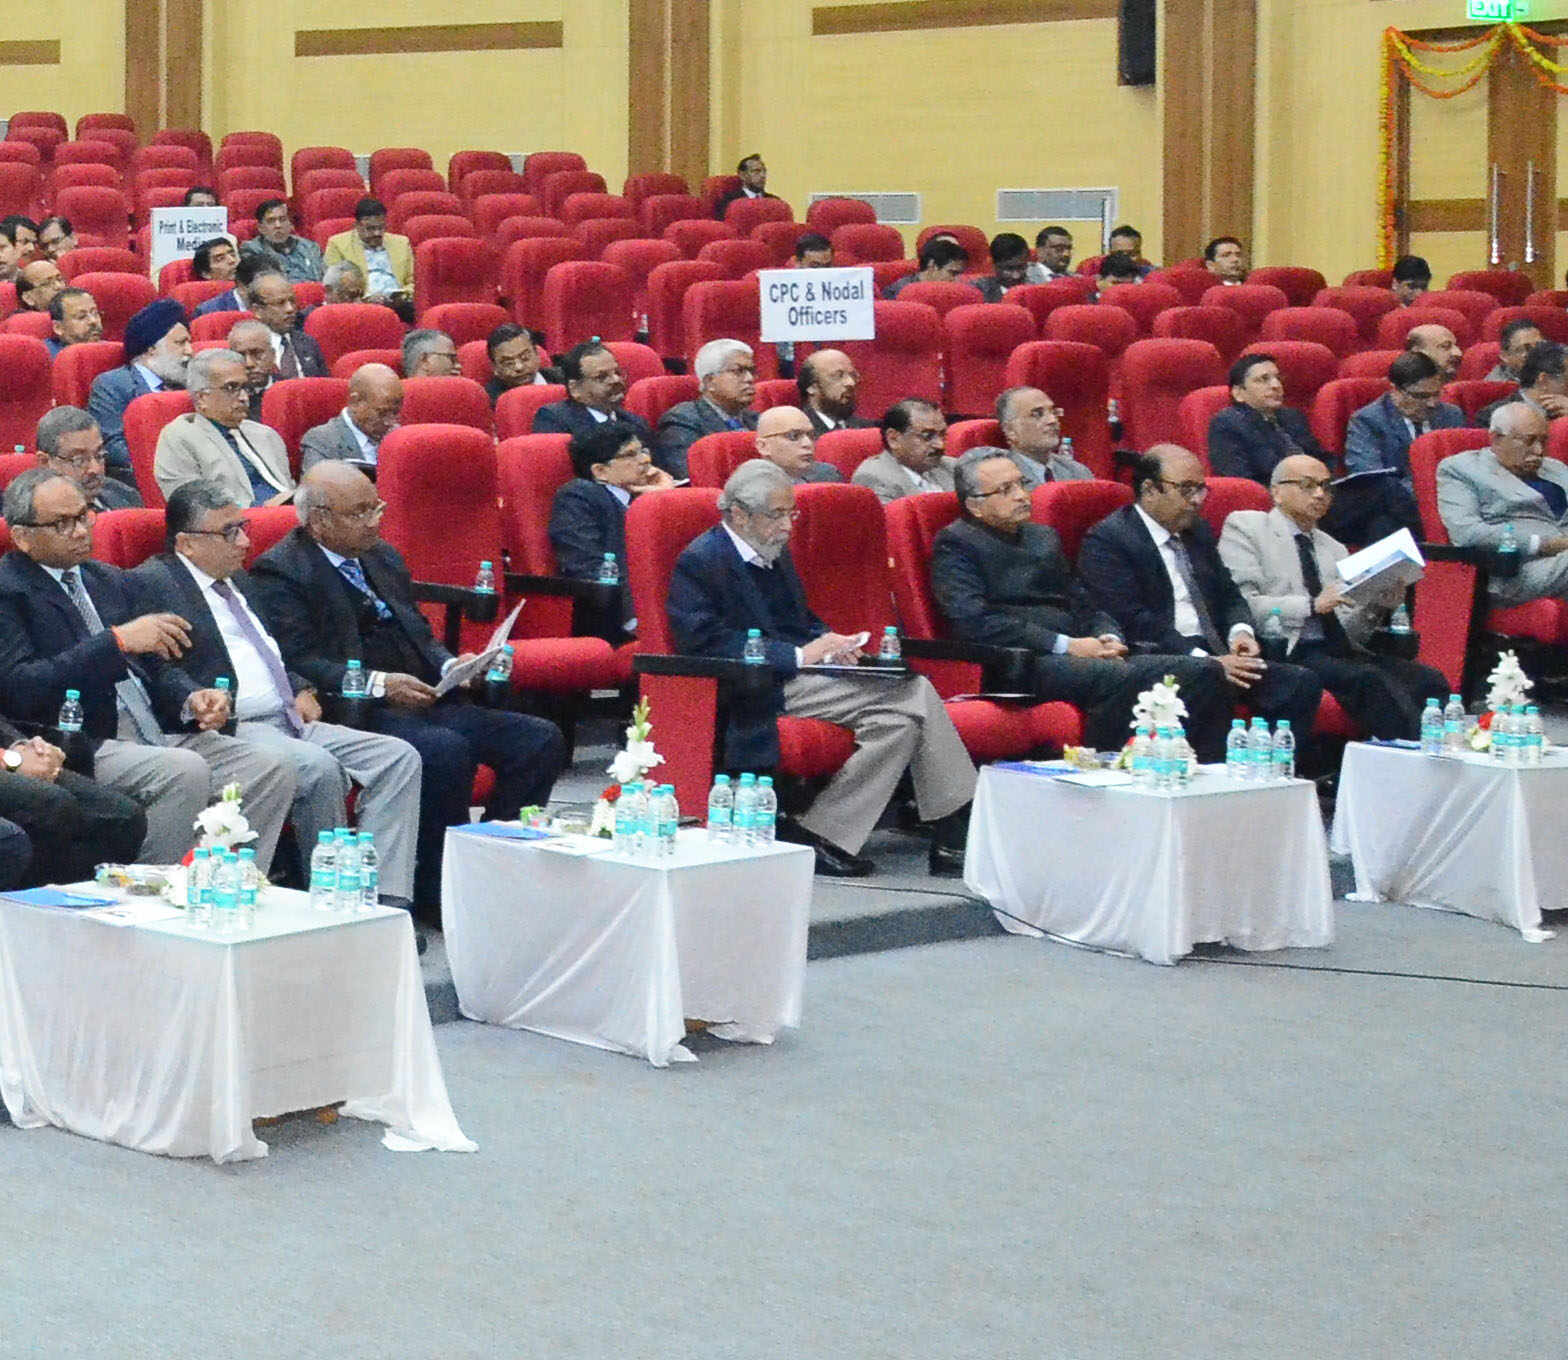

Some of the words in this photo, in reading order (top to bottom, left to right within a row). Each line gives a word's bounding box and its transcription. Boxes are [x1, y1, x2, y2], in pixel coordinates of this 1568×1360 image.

[1471, 0, 1510, 16] EXIT
[769, 282, 799, 303] CPC
[805, 282, 816, 302] &
[821, 279, 865, 301] Nodal
[787, 305, 848, 327] Officers
